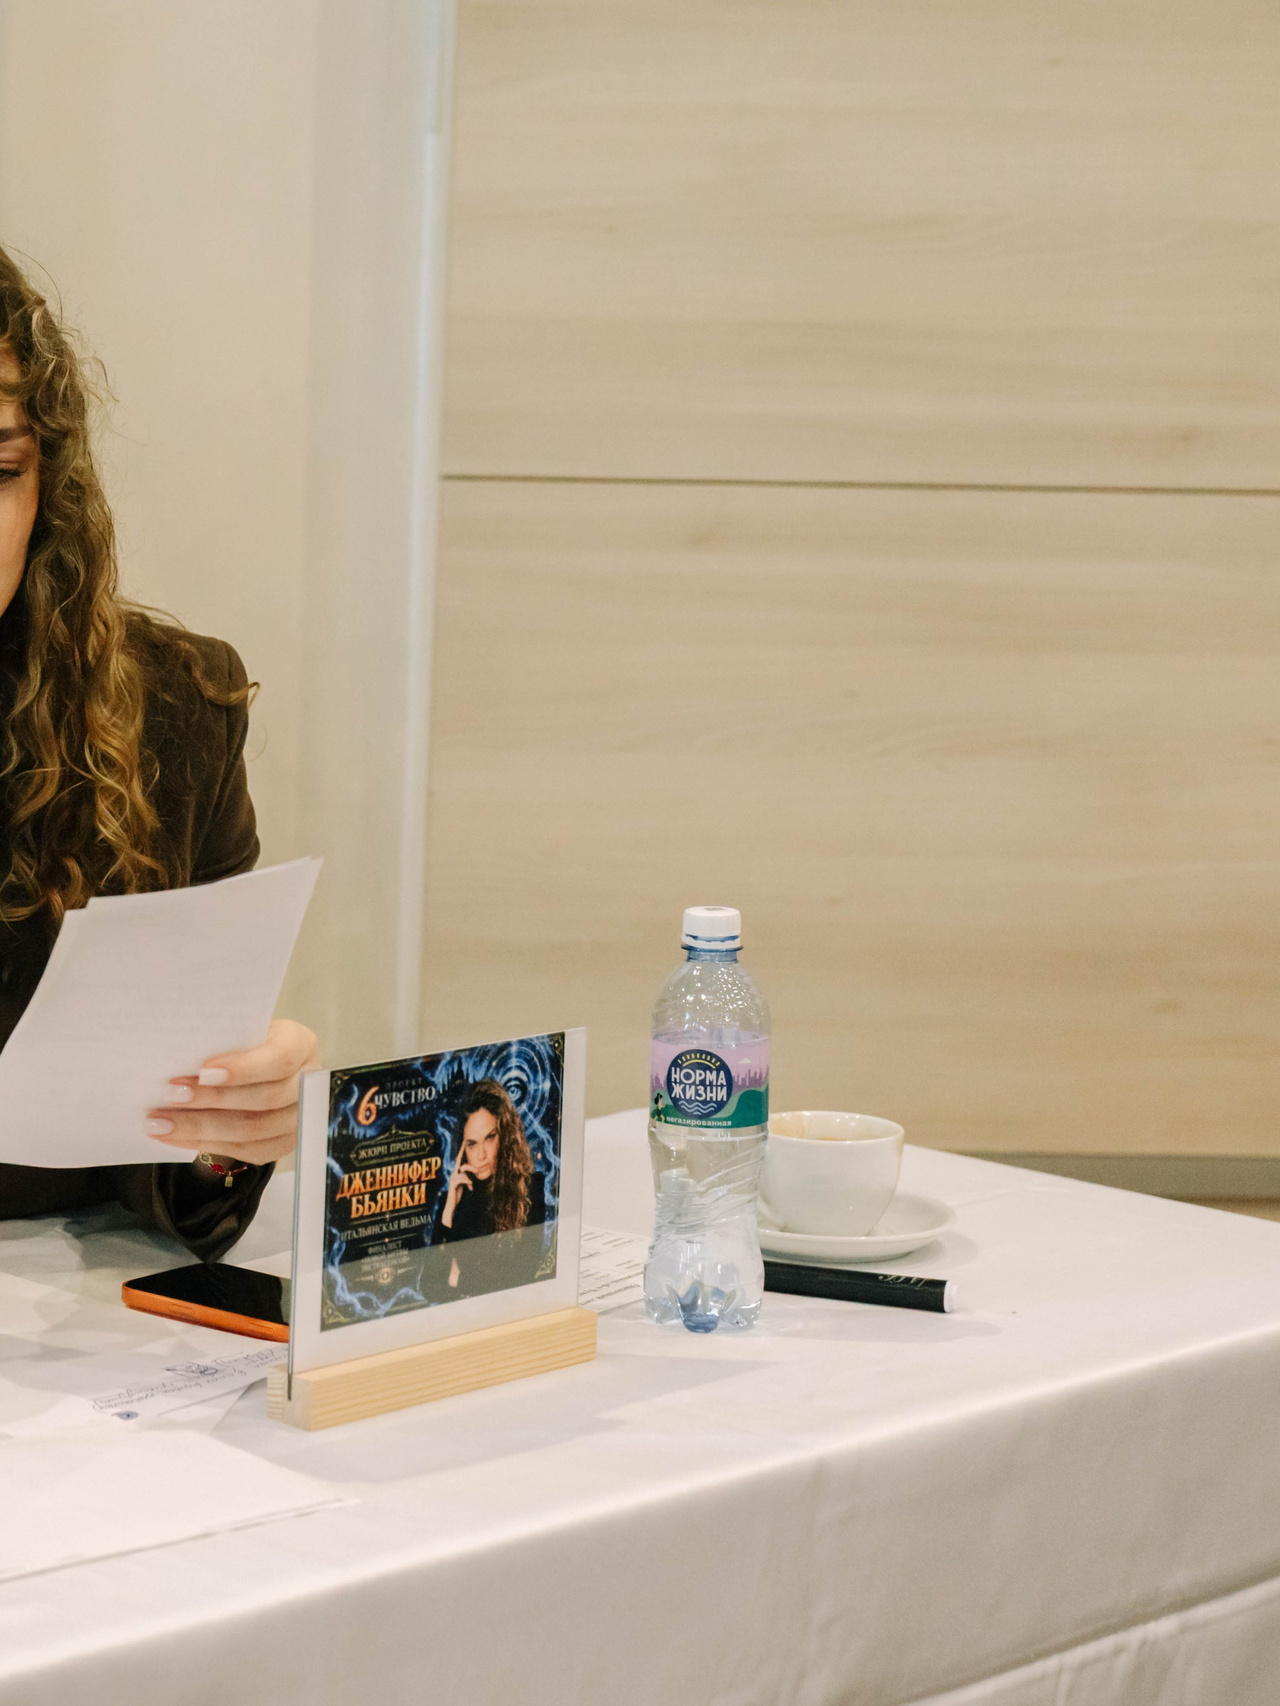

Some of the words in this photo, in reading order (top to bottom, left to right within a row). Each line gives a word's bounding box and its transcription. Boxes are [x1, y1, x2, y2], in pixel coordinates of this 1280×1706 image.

[671, 1067, 727, 1085] НОРМА
[671, 1083, 727, 1102] ЖИЗНИ
[356, 1086, 380, 1126] 6
[374, 1085, 437, 1110] ЧУВСТВО
[666, 1115, 732, 1127] негазированная
[358, 1145, 388, 1159] ЖЮРИ
[389, 1138, 427, 1153] ПРОЕКТА
[336, 1156, 442, 1201] ДЖЕННИФЕР
[351, 1183, 427, 1219] БЬЯНКИ
[341, 1222, 400, 1241] ИТАЛЬЯНСКАЯ
[401, 1214, 432, 1230] ВЕДЬМА
